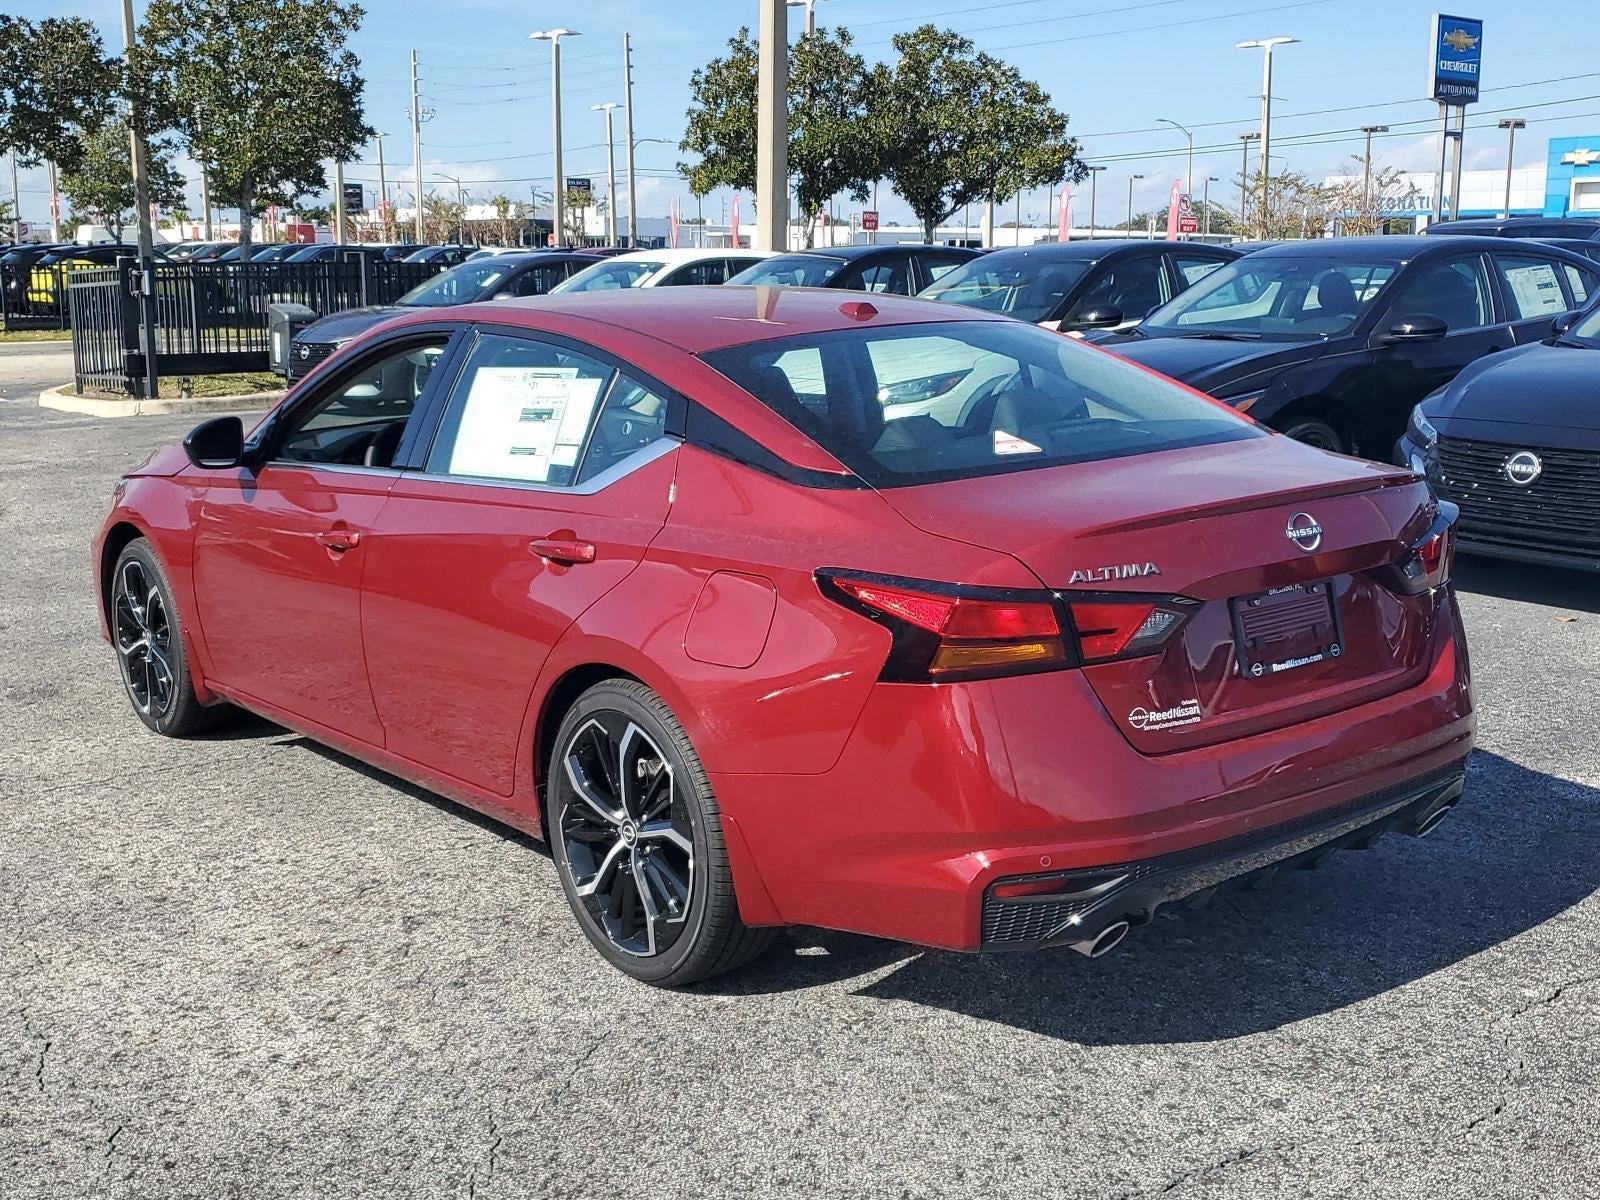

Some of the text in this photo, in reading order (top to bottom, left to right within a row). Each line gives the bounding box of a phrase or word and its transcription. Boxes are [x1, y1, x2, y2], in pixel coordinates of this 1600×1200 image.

[1440, 61, 1477, 73] CHEVROLET
[1439, 84, 1477, 96] AUTONATION
[1506, 463, 1541, 473] NISSAN
[1286, 524, 1322, 538] NISSAN
[1069, 562, 1160, 584] ALTIMA
[1272, 653, 1323, 672] ReedNissan.com
